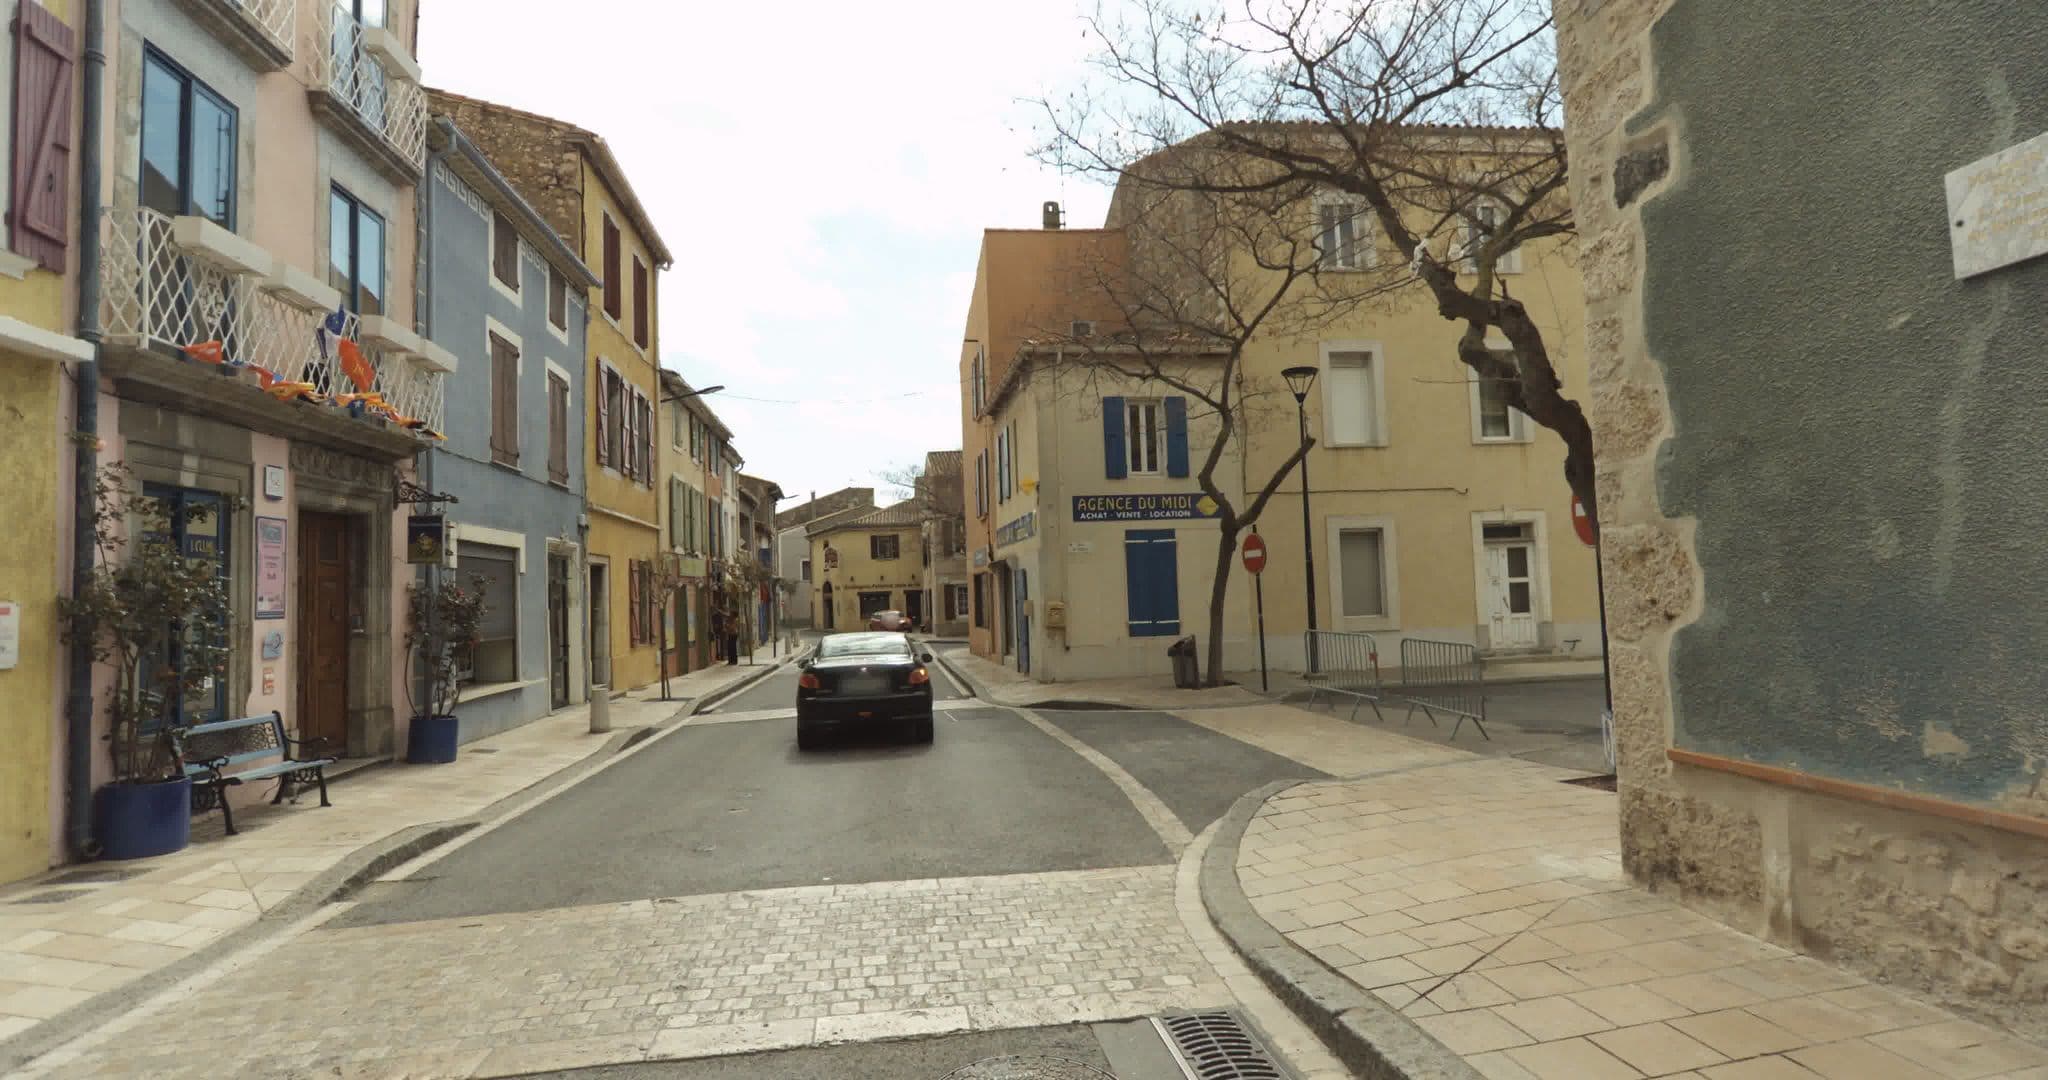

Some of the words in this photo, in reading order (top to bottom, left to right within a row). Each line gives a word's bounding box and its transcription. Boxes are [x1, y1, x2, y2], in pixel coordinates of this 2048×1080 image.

[1077, 496, 1133, 511] AGENCE
[1138, 496, 1156, 510] DU
[1161, 495, 1192, 509] MIDI
[1079, 511, 1108, 520] ACHAT
[1116, 511, 1141, 519] VENTE
[1149, 510, 1191, 518] LOCATION
